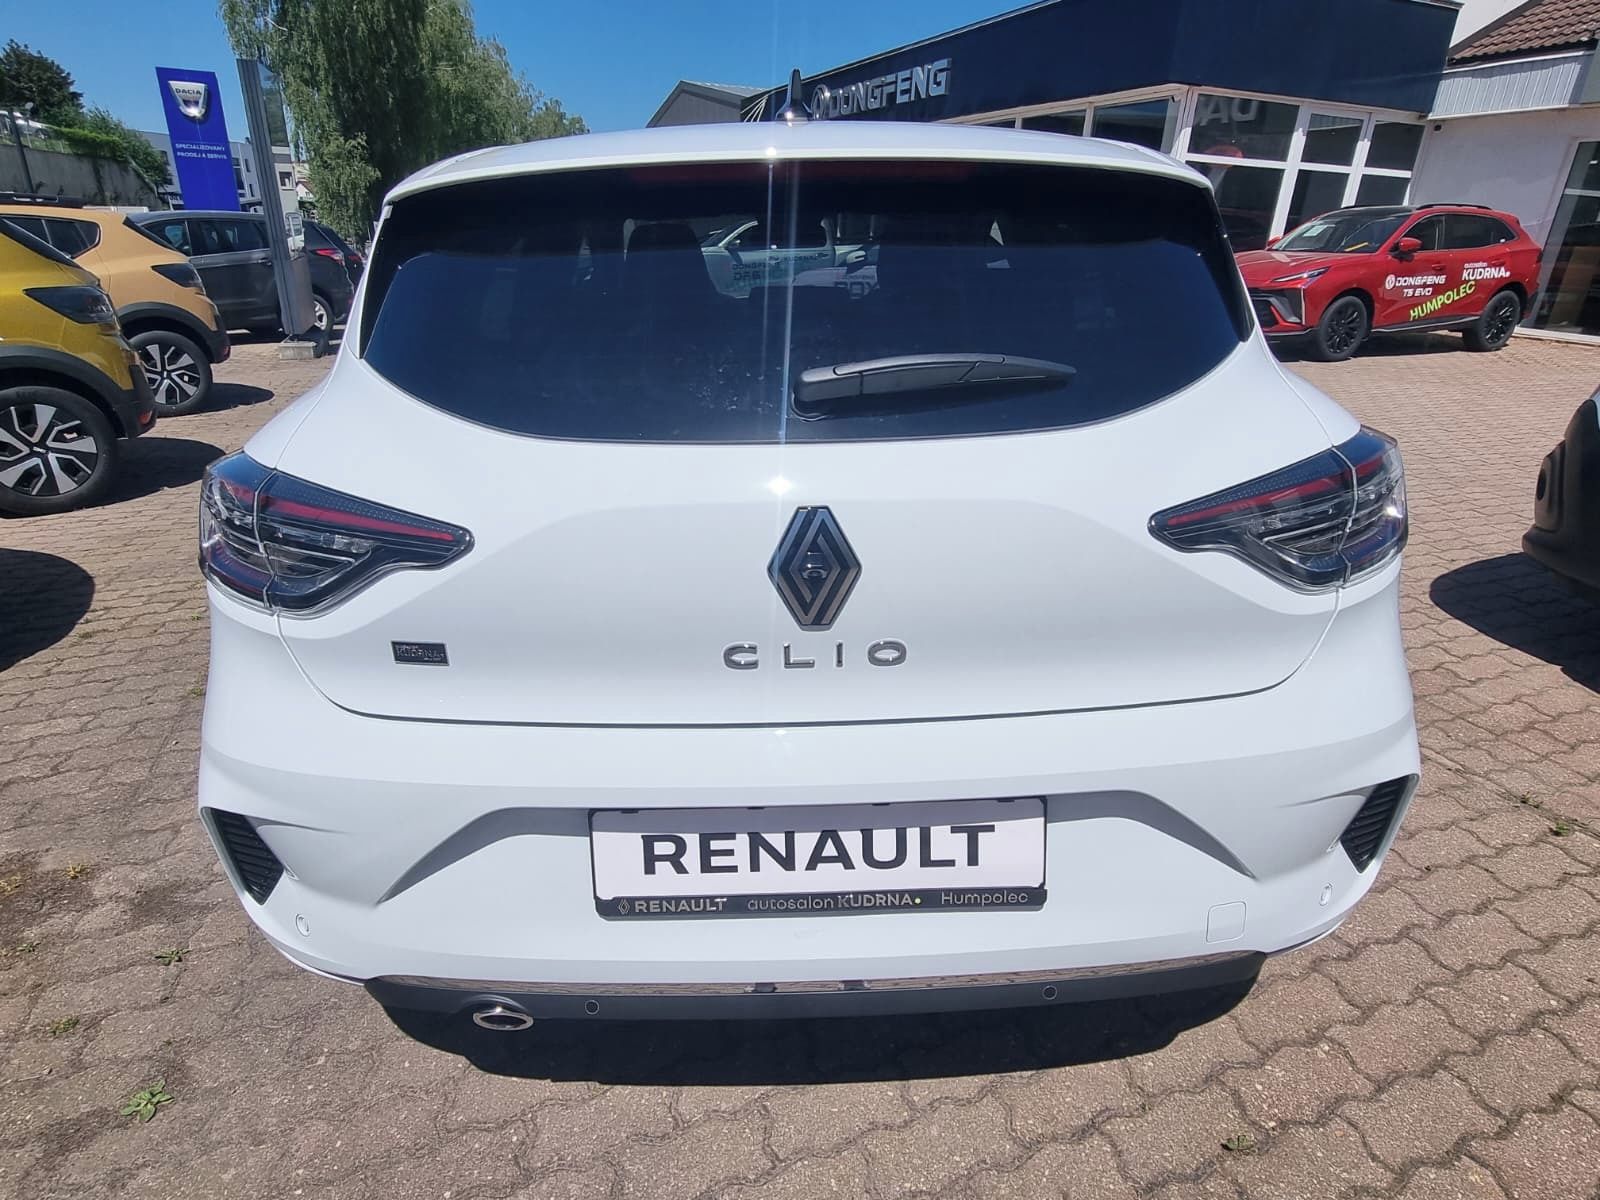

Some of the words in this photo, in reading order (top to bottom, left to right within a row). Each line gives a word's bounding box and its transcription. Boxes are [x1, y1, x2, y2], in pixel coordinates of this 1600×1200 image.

[175, 87, 203, 96] DACIA
[828, 57, 952, 117] DONGFENG
[1395, 274, 1447, 287] DONGFENG
[1414, 287, 1433, 297] EVO
[1409, 280, 1476, 321] HUMPOLEC
[723, 639, 908, 670] CLIO
[640, 823, 995, 875] RENAULT
[634, 897, 727, 913] RENAULT
[747, 895, 834, 911] autosalon
[941, 890, 1029, 907] Humpolec
